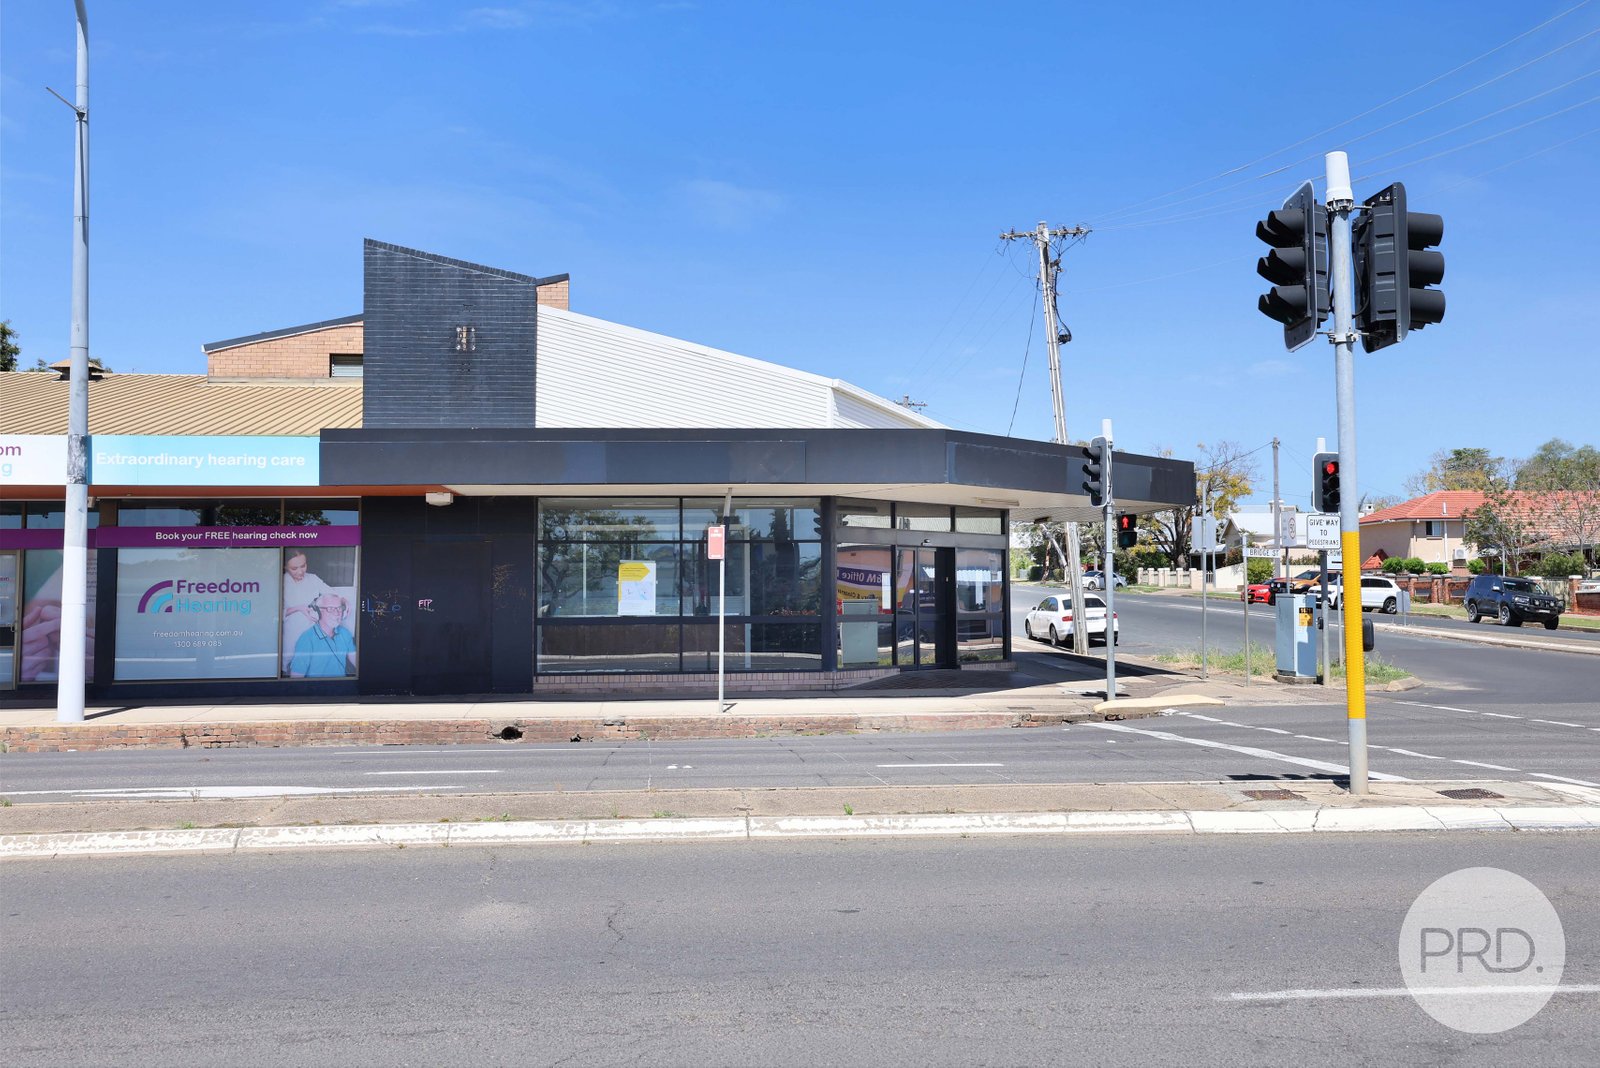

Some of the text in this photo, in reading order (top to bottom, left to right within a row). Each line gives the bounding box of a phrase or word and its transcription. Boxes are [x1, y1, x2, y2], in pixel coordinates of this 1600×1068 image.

[96, 453, 305, 469] Extraordinary hearing care
[155, 532, 179, 540] Book
[181, 533, 203, 542] your
[205, 532, 230, 540] FREE
[232, 531, 267, 541] hearing
[270, 531, 297, 539] check
[1249, 548, 1270, 556] BRIDGE
[177, 578, 260, 594] Freedom
[177, 597, 252, 615] Hearing
